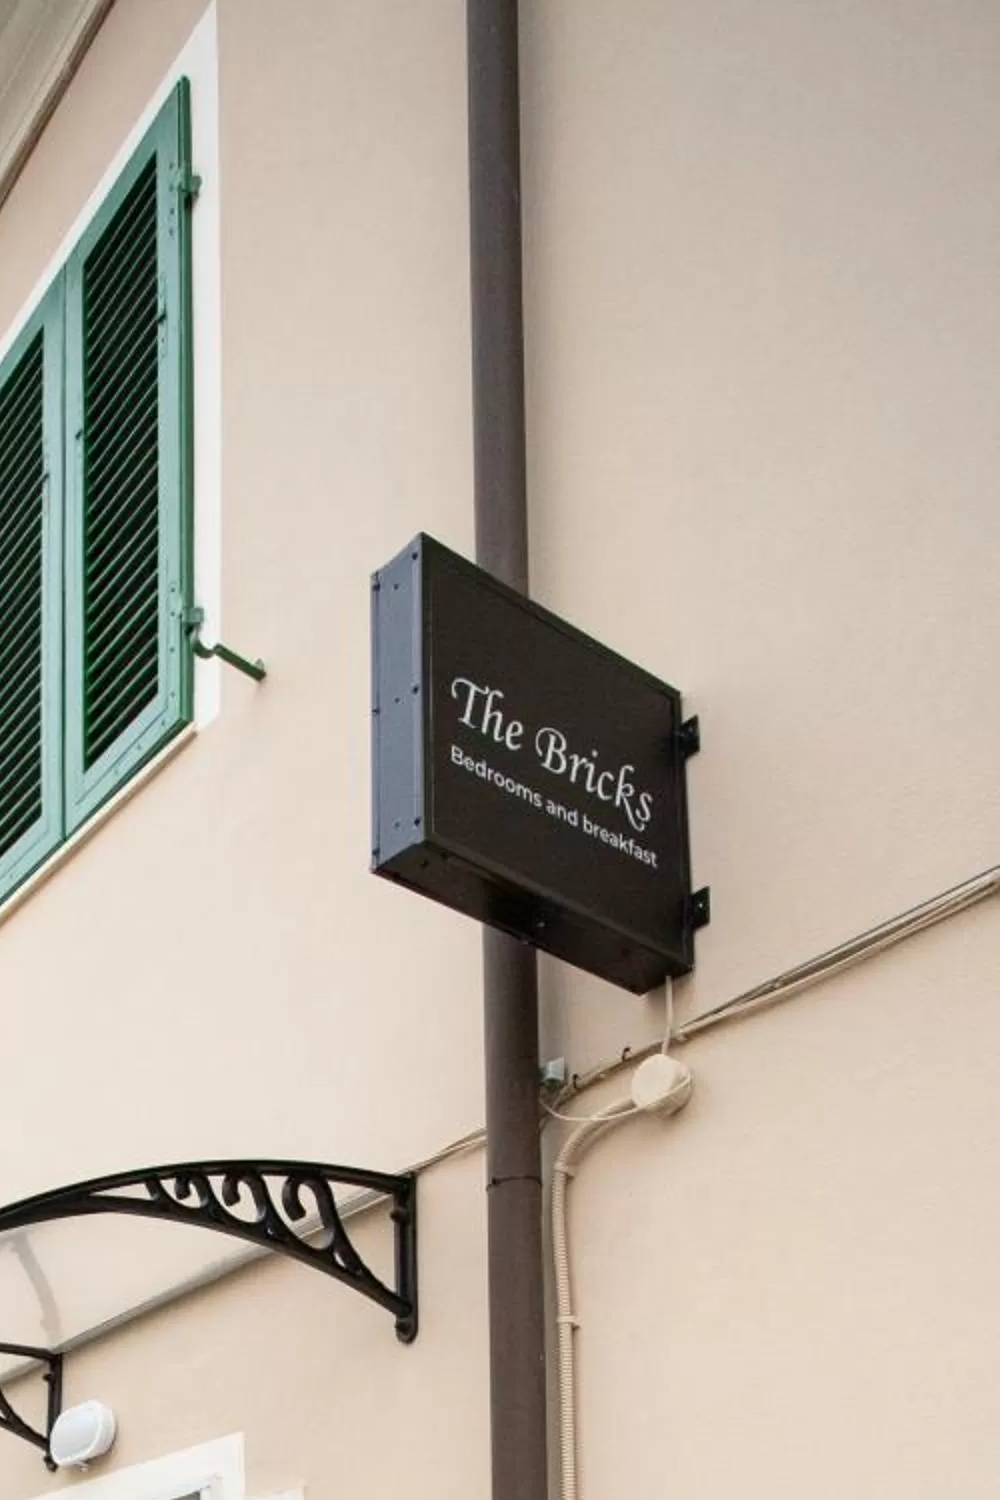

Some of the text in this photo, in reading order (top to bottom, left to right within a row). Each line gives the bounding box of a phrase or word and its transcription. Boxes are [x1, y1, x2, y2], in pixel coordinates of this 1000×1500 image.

[451, 678, 653, 832] The Bricks
[451, 744, 658, 869] Bedrooms and breakfast
